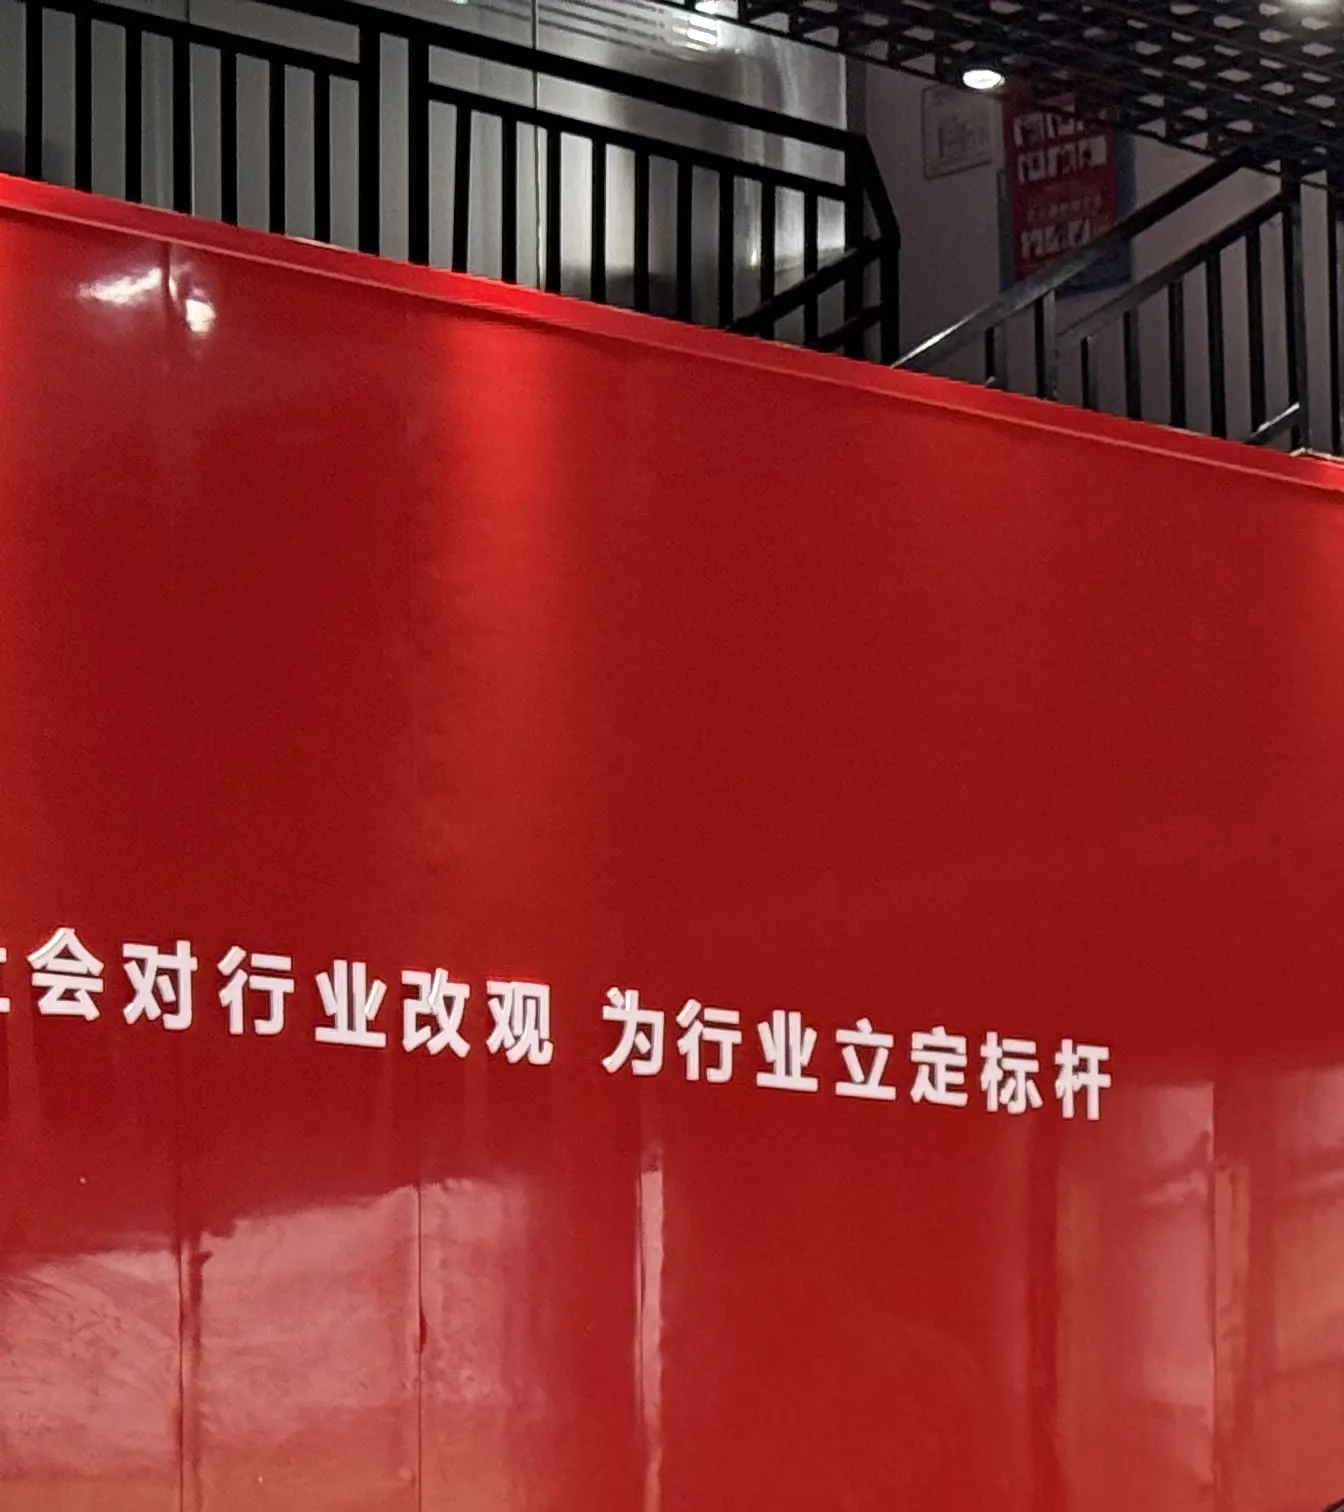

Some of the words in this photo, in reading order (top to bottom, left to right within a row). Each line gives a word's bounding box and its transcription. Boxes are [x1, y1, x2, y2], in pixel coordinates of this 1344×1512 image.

[0, 926, 554, 1065] 会对行业改观
[602, 985, 1113, 1121] 为行业立定标杆
